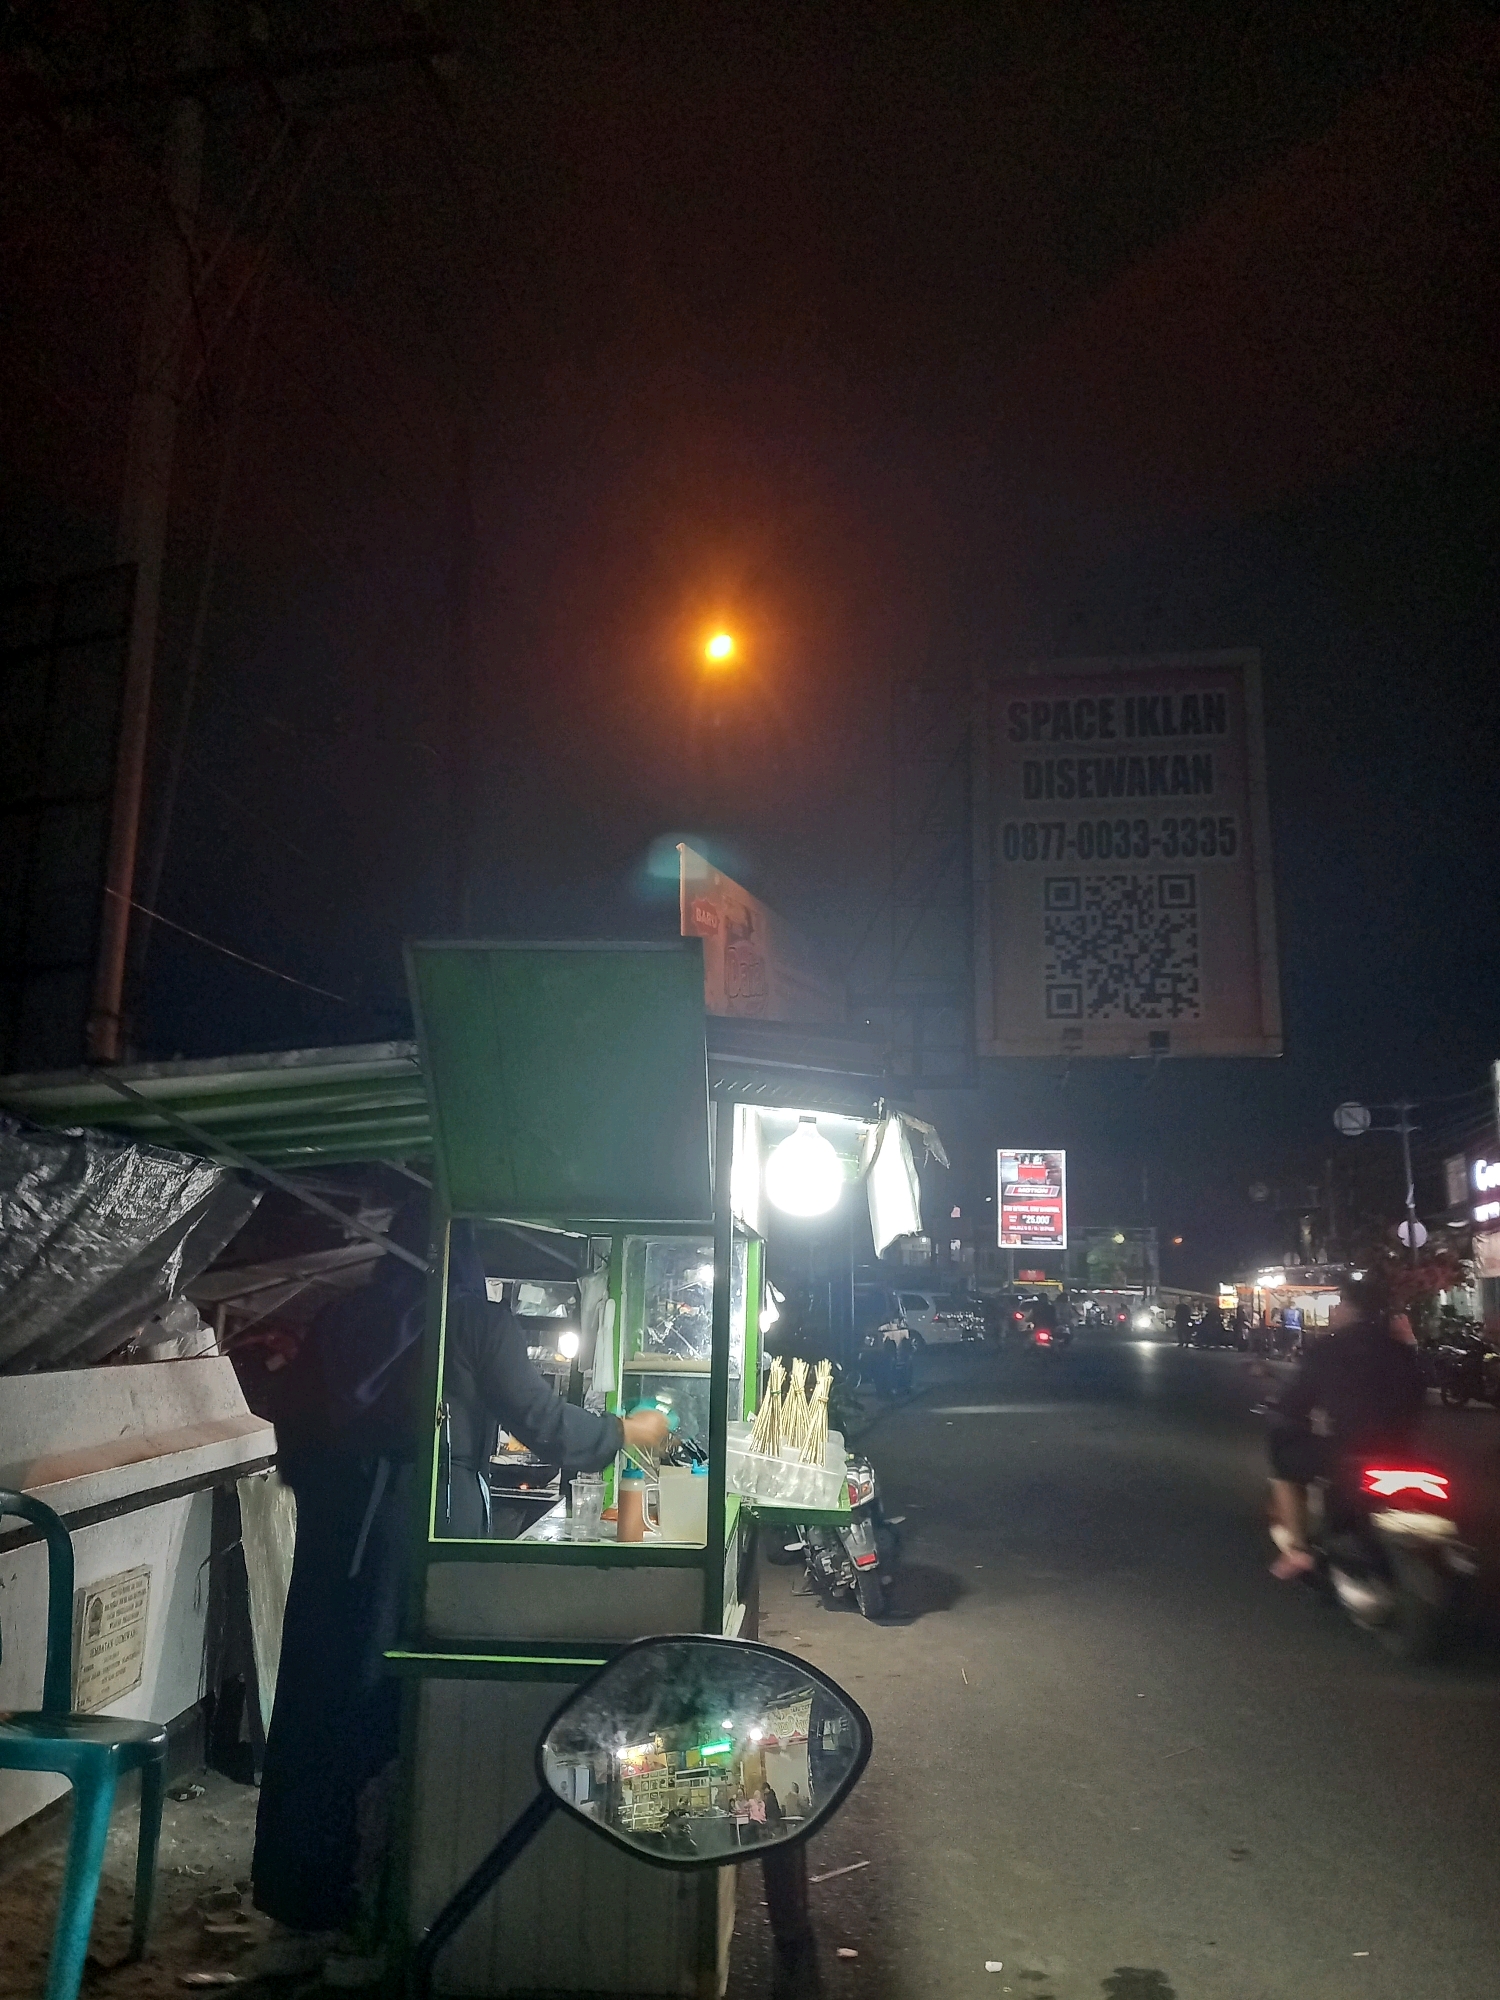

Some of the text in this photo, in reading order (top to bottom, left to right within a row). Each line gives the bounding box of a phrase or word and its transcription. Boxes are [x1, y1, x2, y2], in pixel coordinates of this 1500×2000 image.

[1008, 694, 1226, 742] SPACE IKLAN
[1023, 755, 1213, 799] DISEWAKAN
[1004, 817, 1237, 861] 0877-0033-3335
